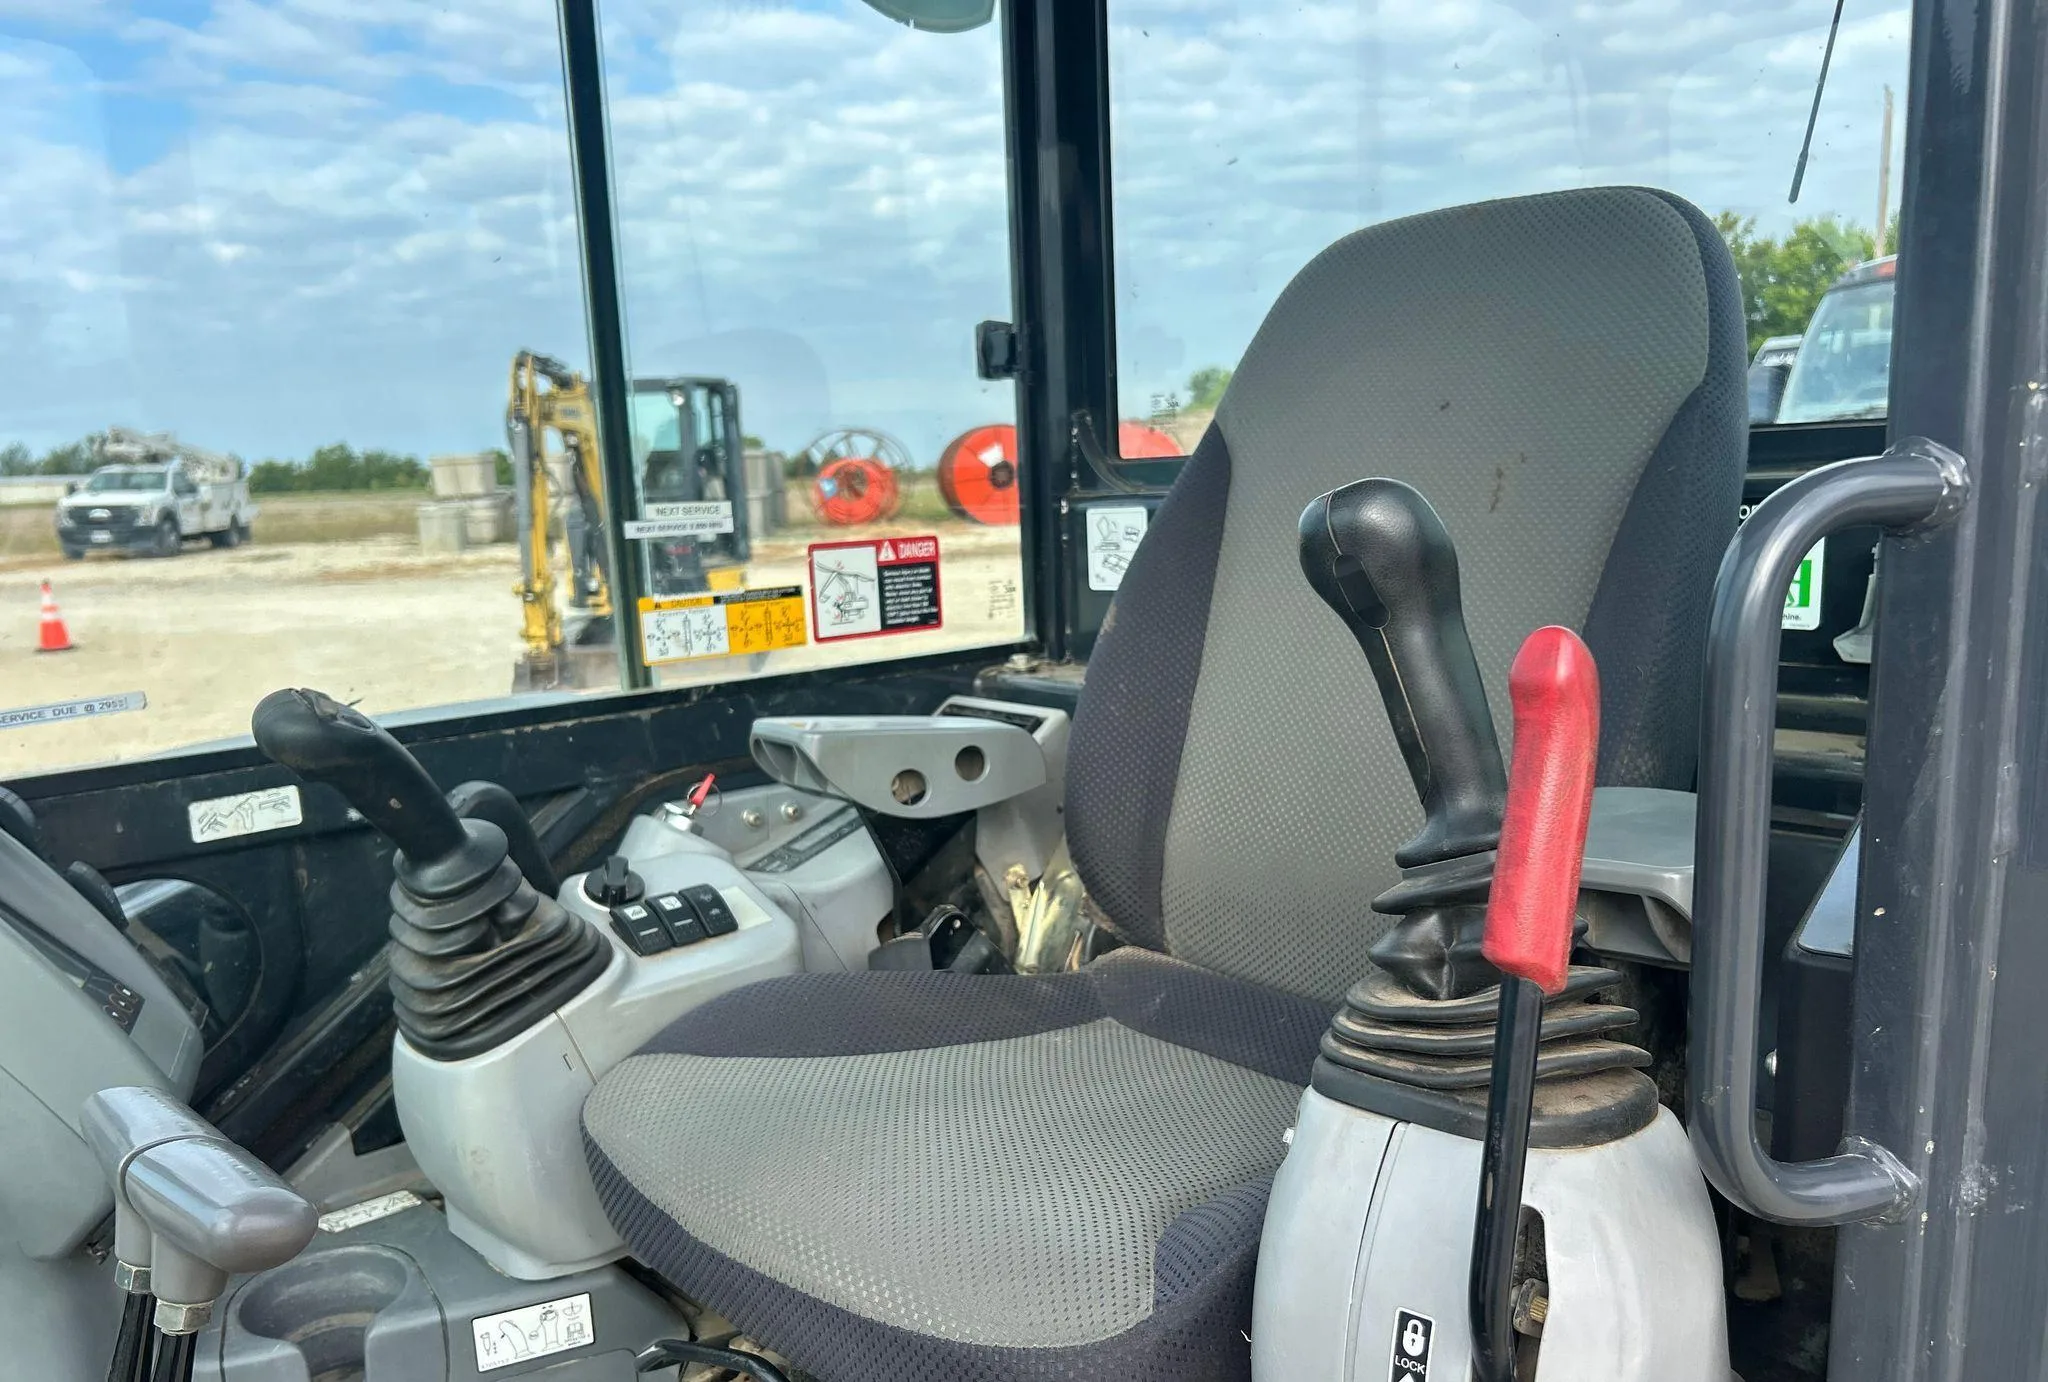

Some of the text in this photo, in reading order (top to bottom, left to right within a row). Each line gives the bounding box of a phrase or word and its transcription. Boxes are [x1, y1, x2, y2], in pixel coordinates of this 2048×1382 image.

[656, 504, 721, 517] NEXT SERVICE
[898, 541, 936, 559] DANGER
[0, 710, 46, 723] ERVICE
[52, 705, 77, 717] DUE
[1395, 1355, 1425, 1375] LOCK
